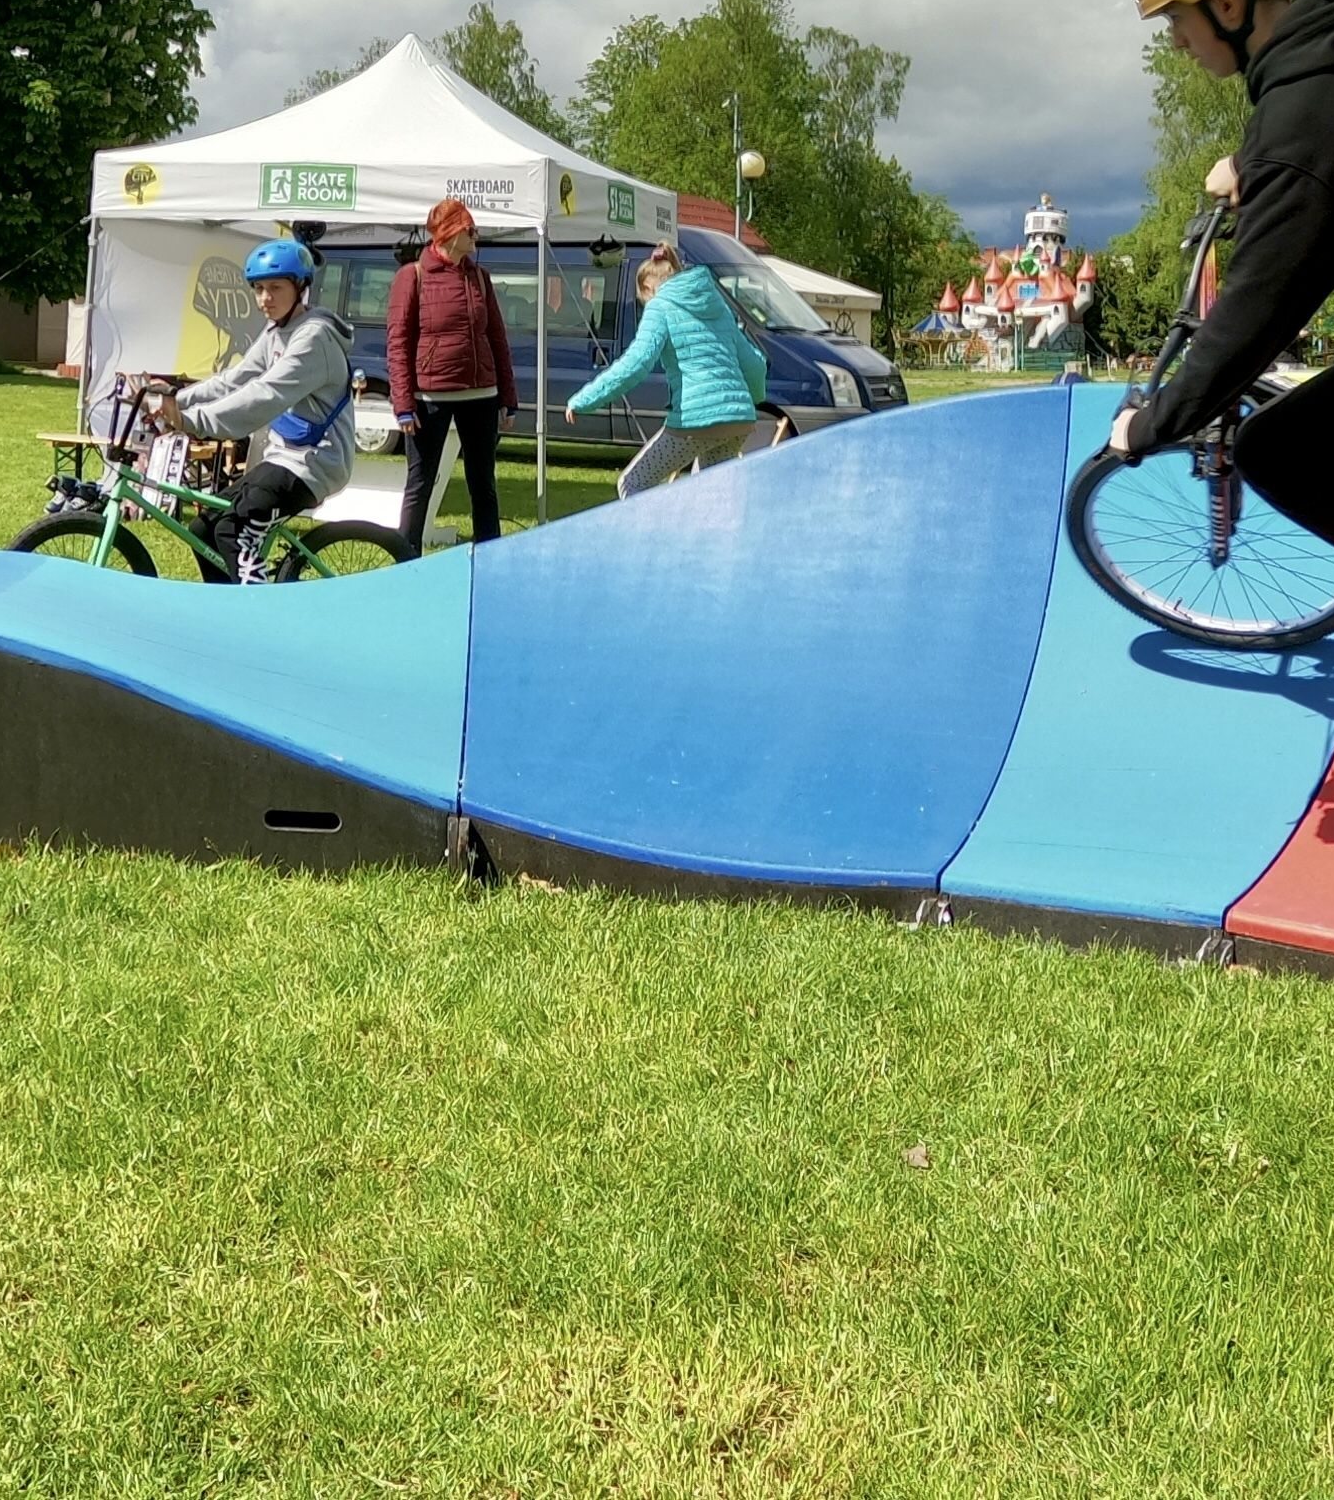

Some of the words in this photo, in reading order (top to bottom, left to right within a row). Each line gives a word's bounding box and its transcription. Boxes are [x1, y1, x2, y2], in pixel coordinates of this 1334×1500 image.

[298, 172, 347, 187] SKATE
[446, 179, 514, 194] SKATEBOARD
[297, 187, 346, 202] ROOM
